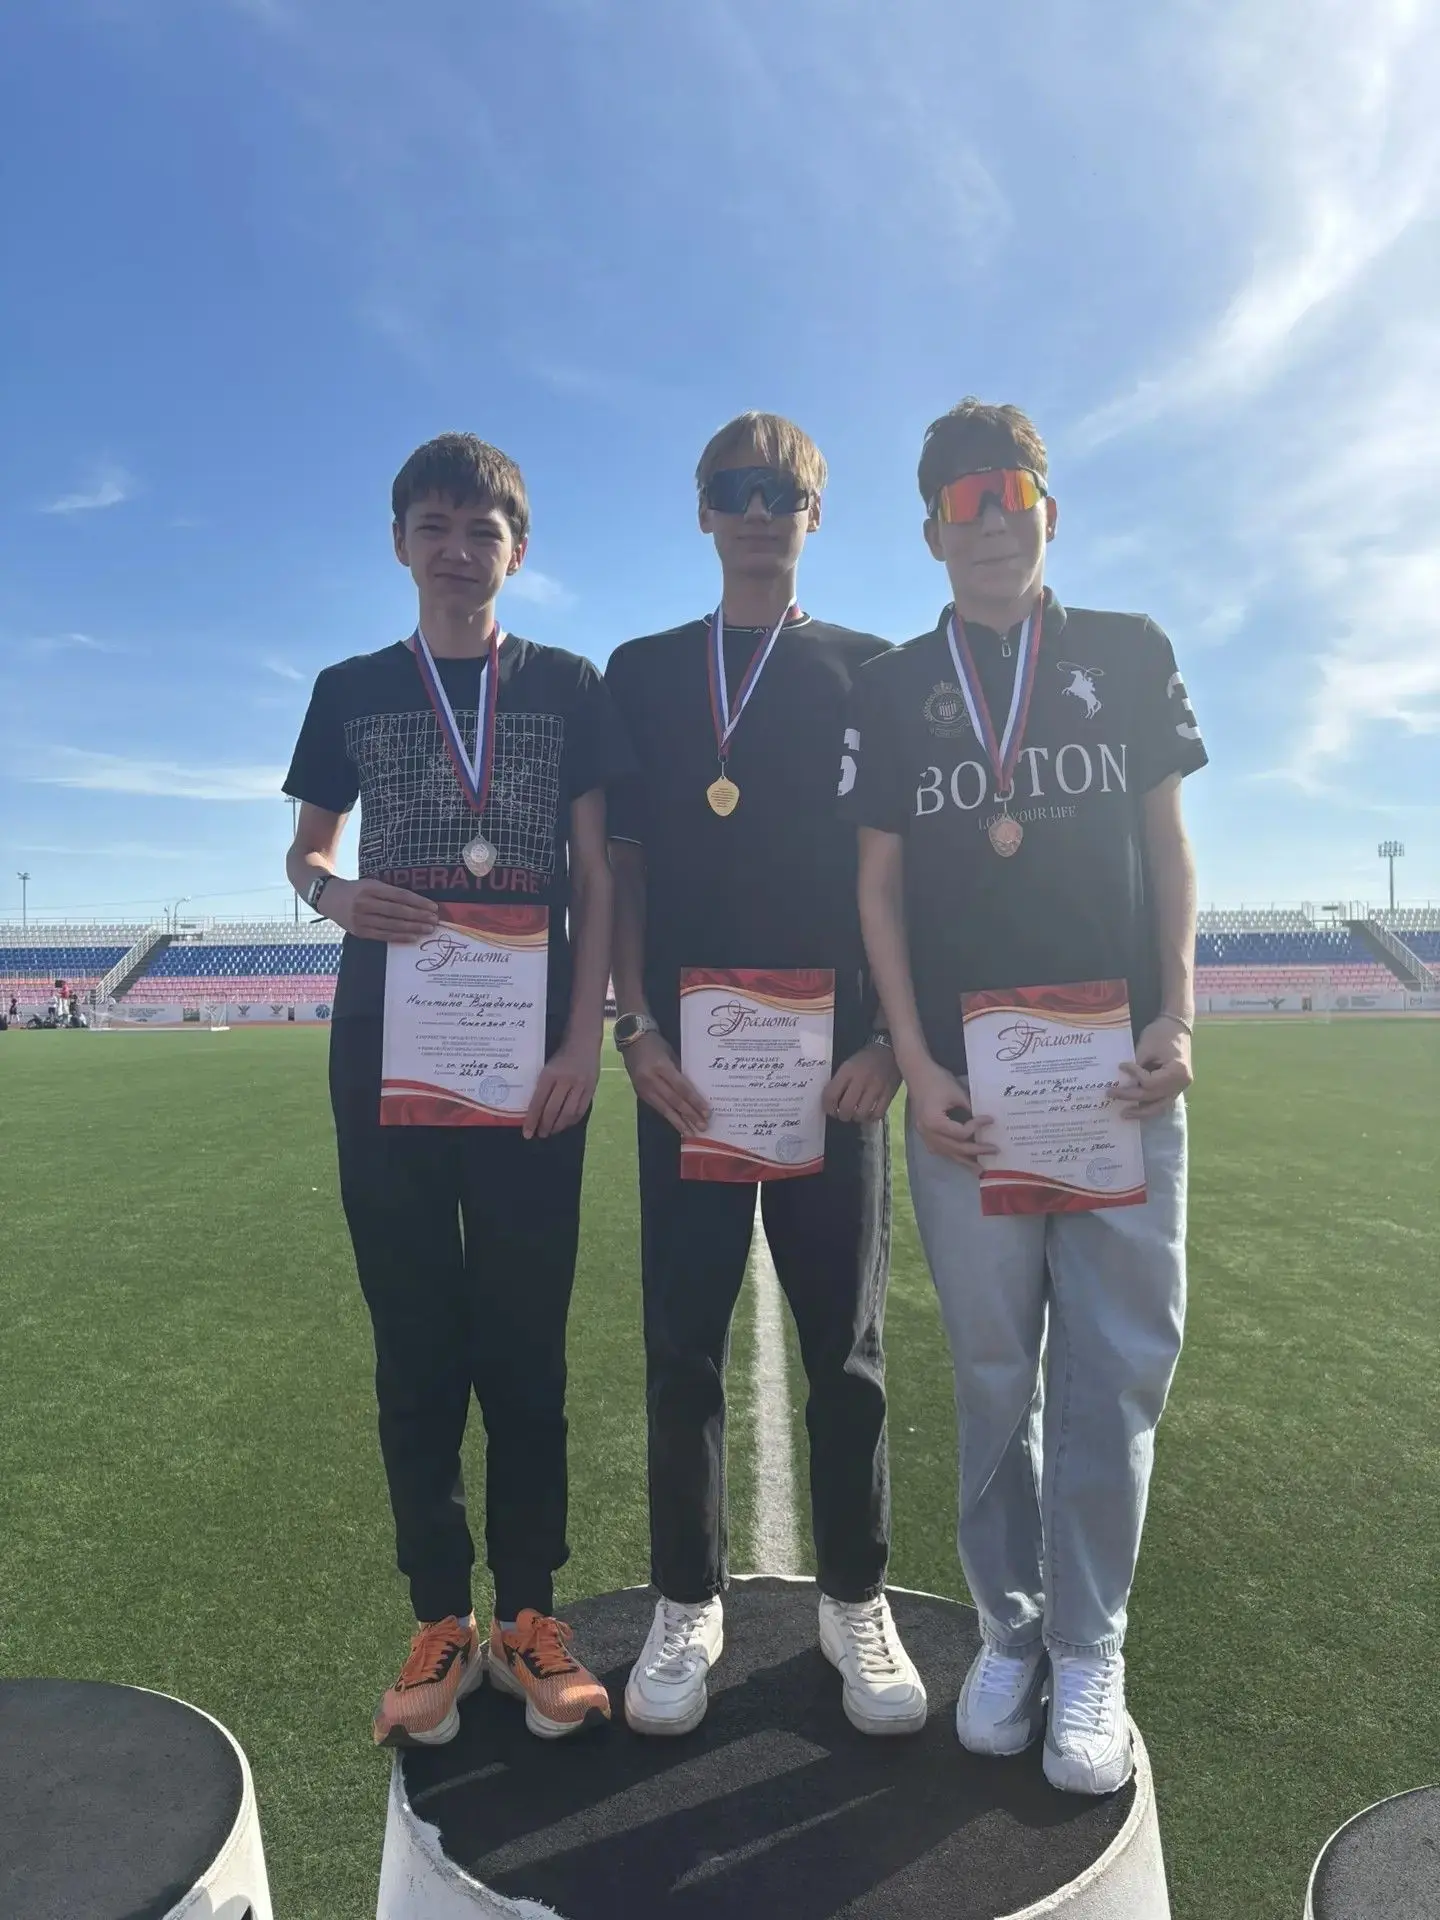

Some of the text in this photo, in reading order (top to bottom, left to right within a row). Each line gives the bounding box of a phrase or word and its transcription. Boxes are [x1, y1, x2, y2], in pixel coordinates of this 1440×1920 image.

[416, 934, 512, 972] Грамота
[707, 999, 800, 1037] Грамота
[996, 1019, 1095, 1062] Грамота
